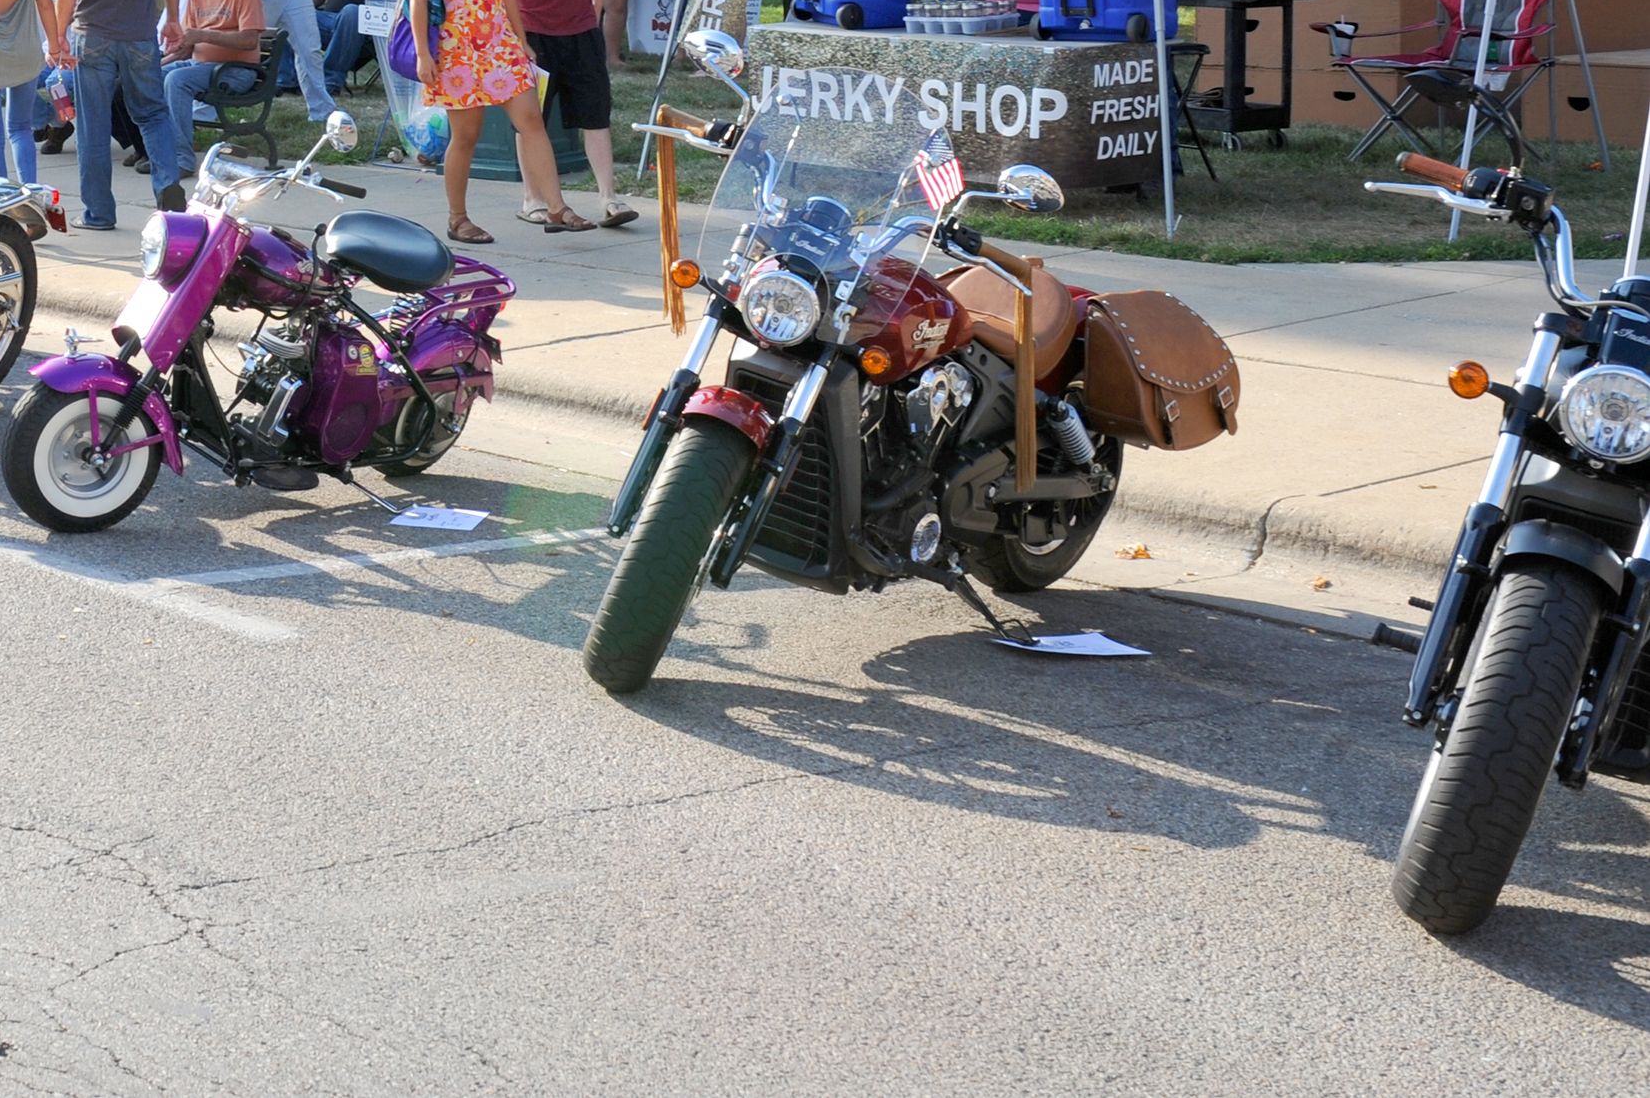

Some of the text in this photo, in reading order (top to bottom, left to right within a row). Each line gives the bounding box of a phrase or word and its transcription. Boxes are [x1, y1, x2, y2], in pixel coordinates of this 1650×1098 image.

[1093, 59, 1154, 88] MADE
[751, 66, 1068, 139] JERKY SHOP
[1090, 94, 1161, 125] FRESH
[1096, 130, 1159, 160] DAILY
